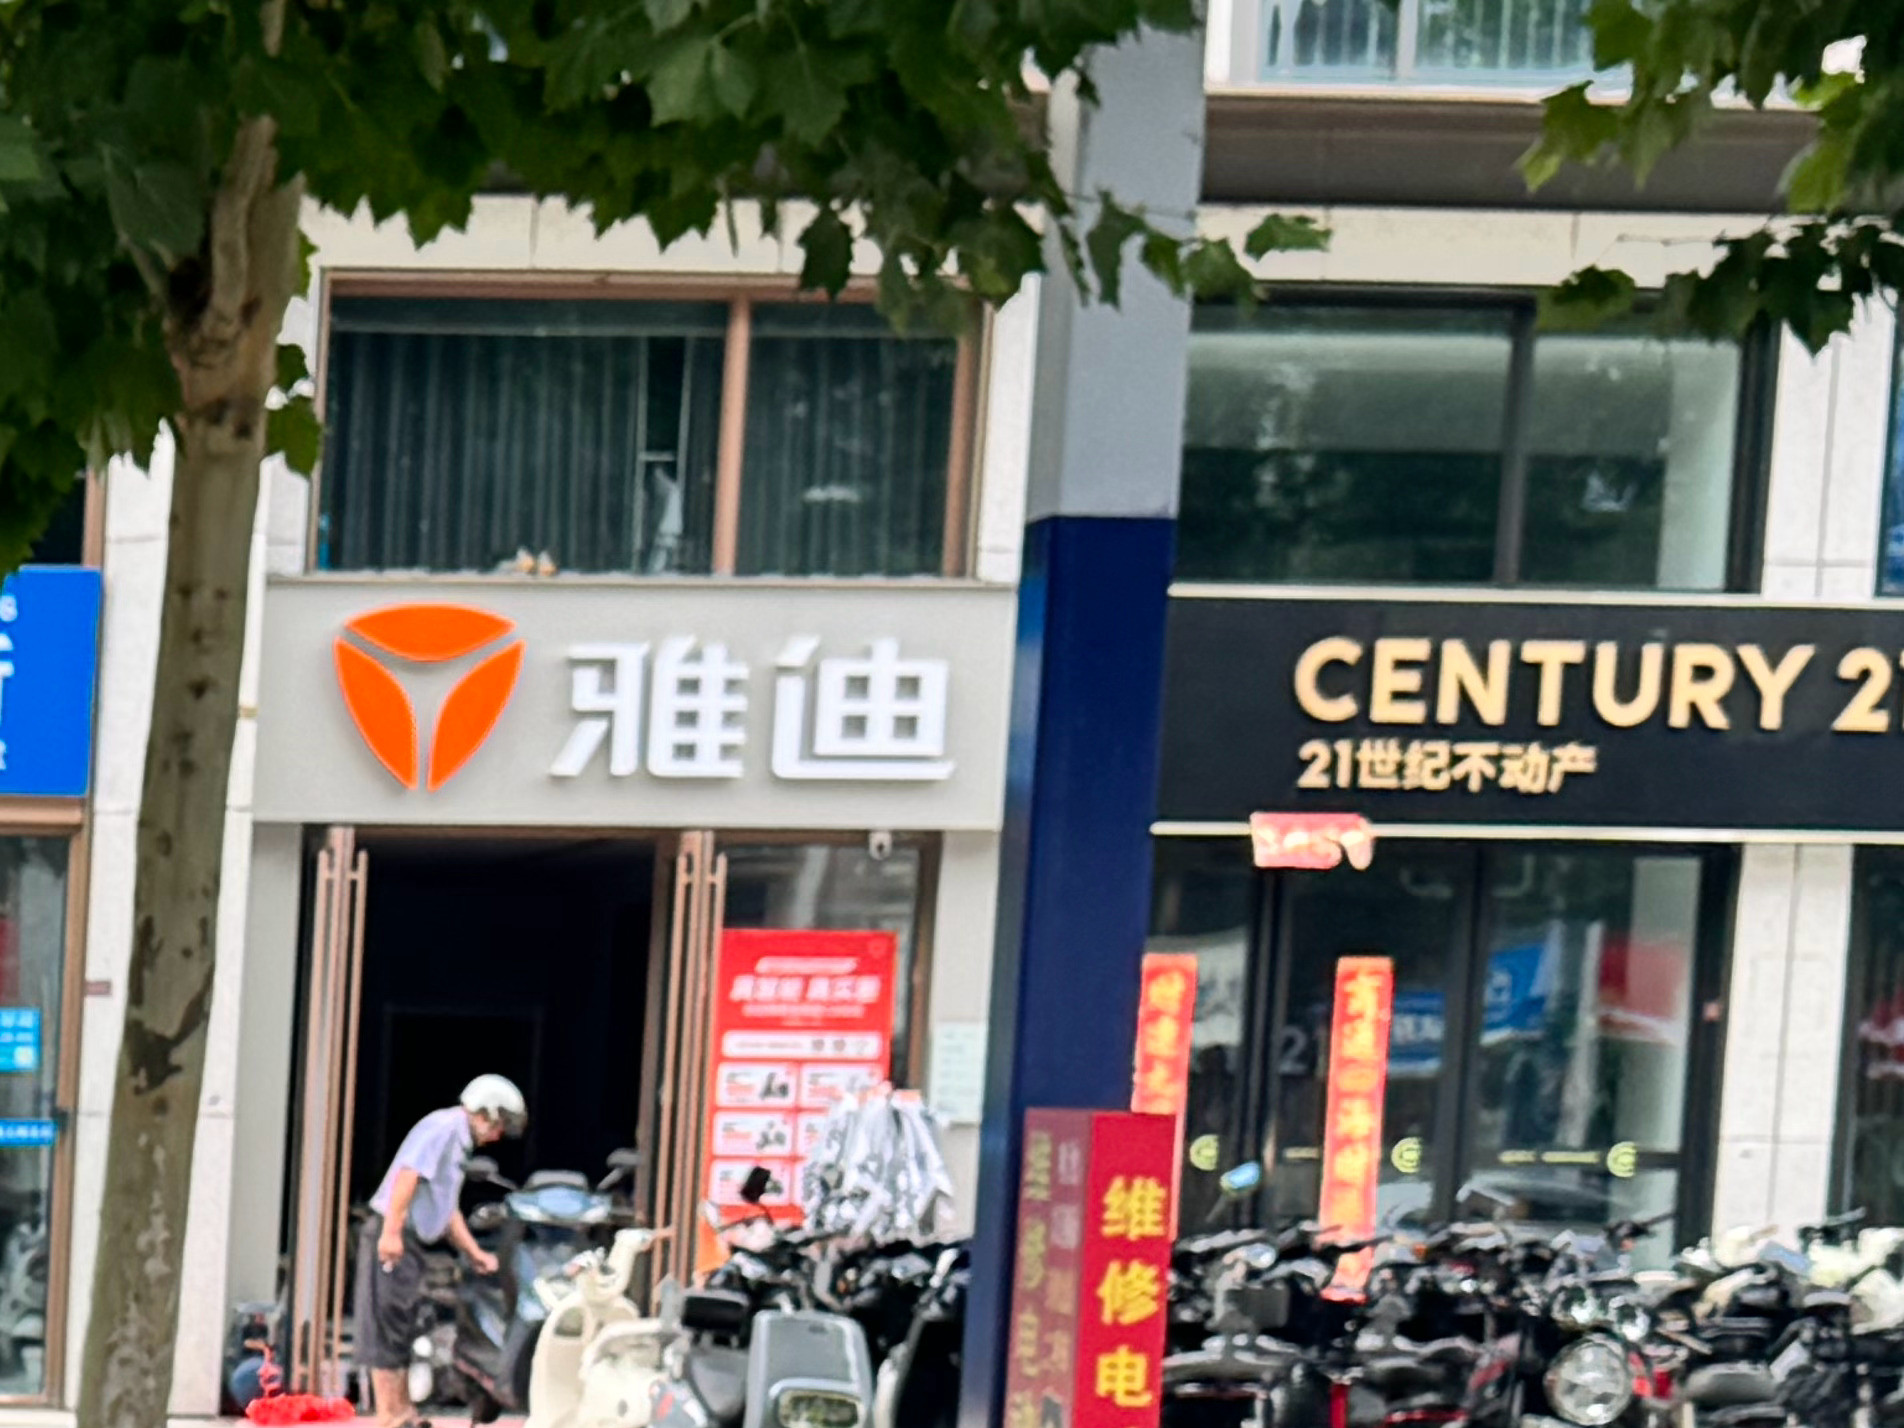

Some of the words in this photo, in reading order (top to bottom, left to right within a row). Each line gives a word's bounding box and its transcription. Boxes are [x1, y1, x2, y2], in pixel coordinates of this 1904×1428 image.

[548, 634, 955, 780] 雅迪
[1294, 637, 1815, 731] CENTURY
[1831, 645, 1904, 733] 2
[1297, 737, 1598, 793] 21世纪不动产
